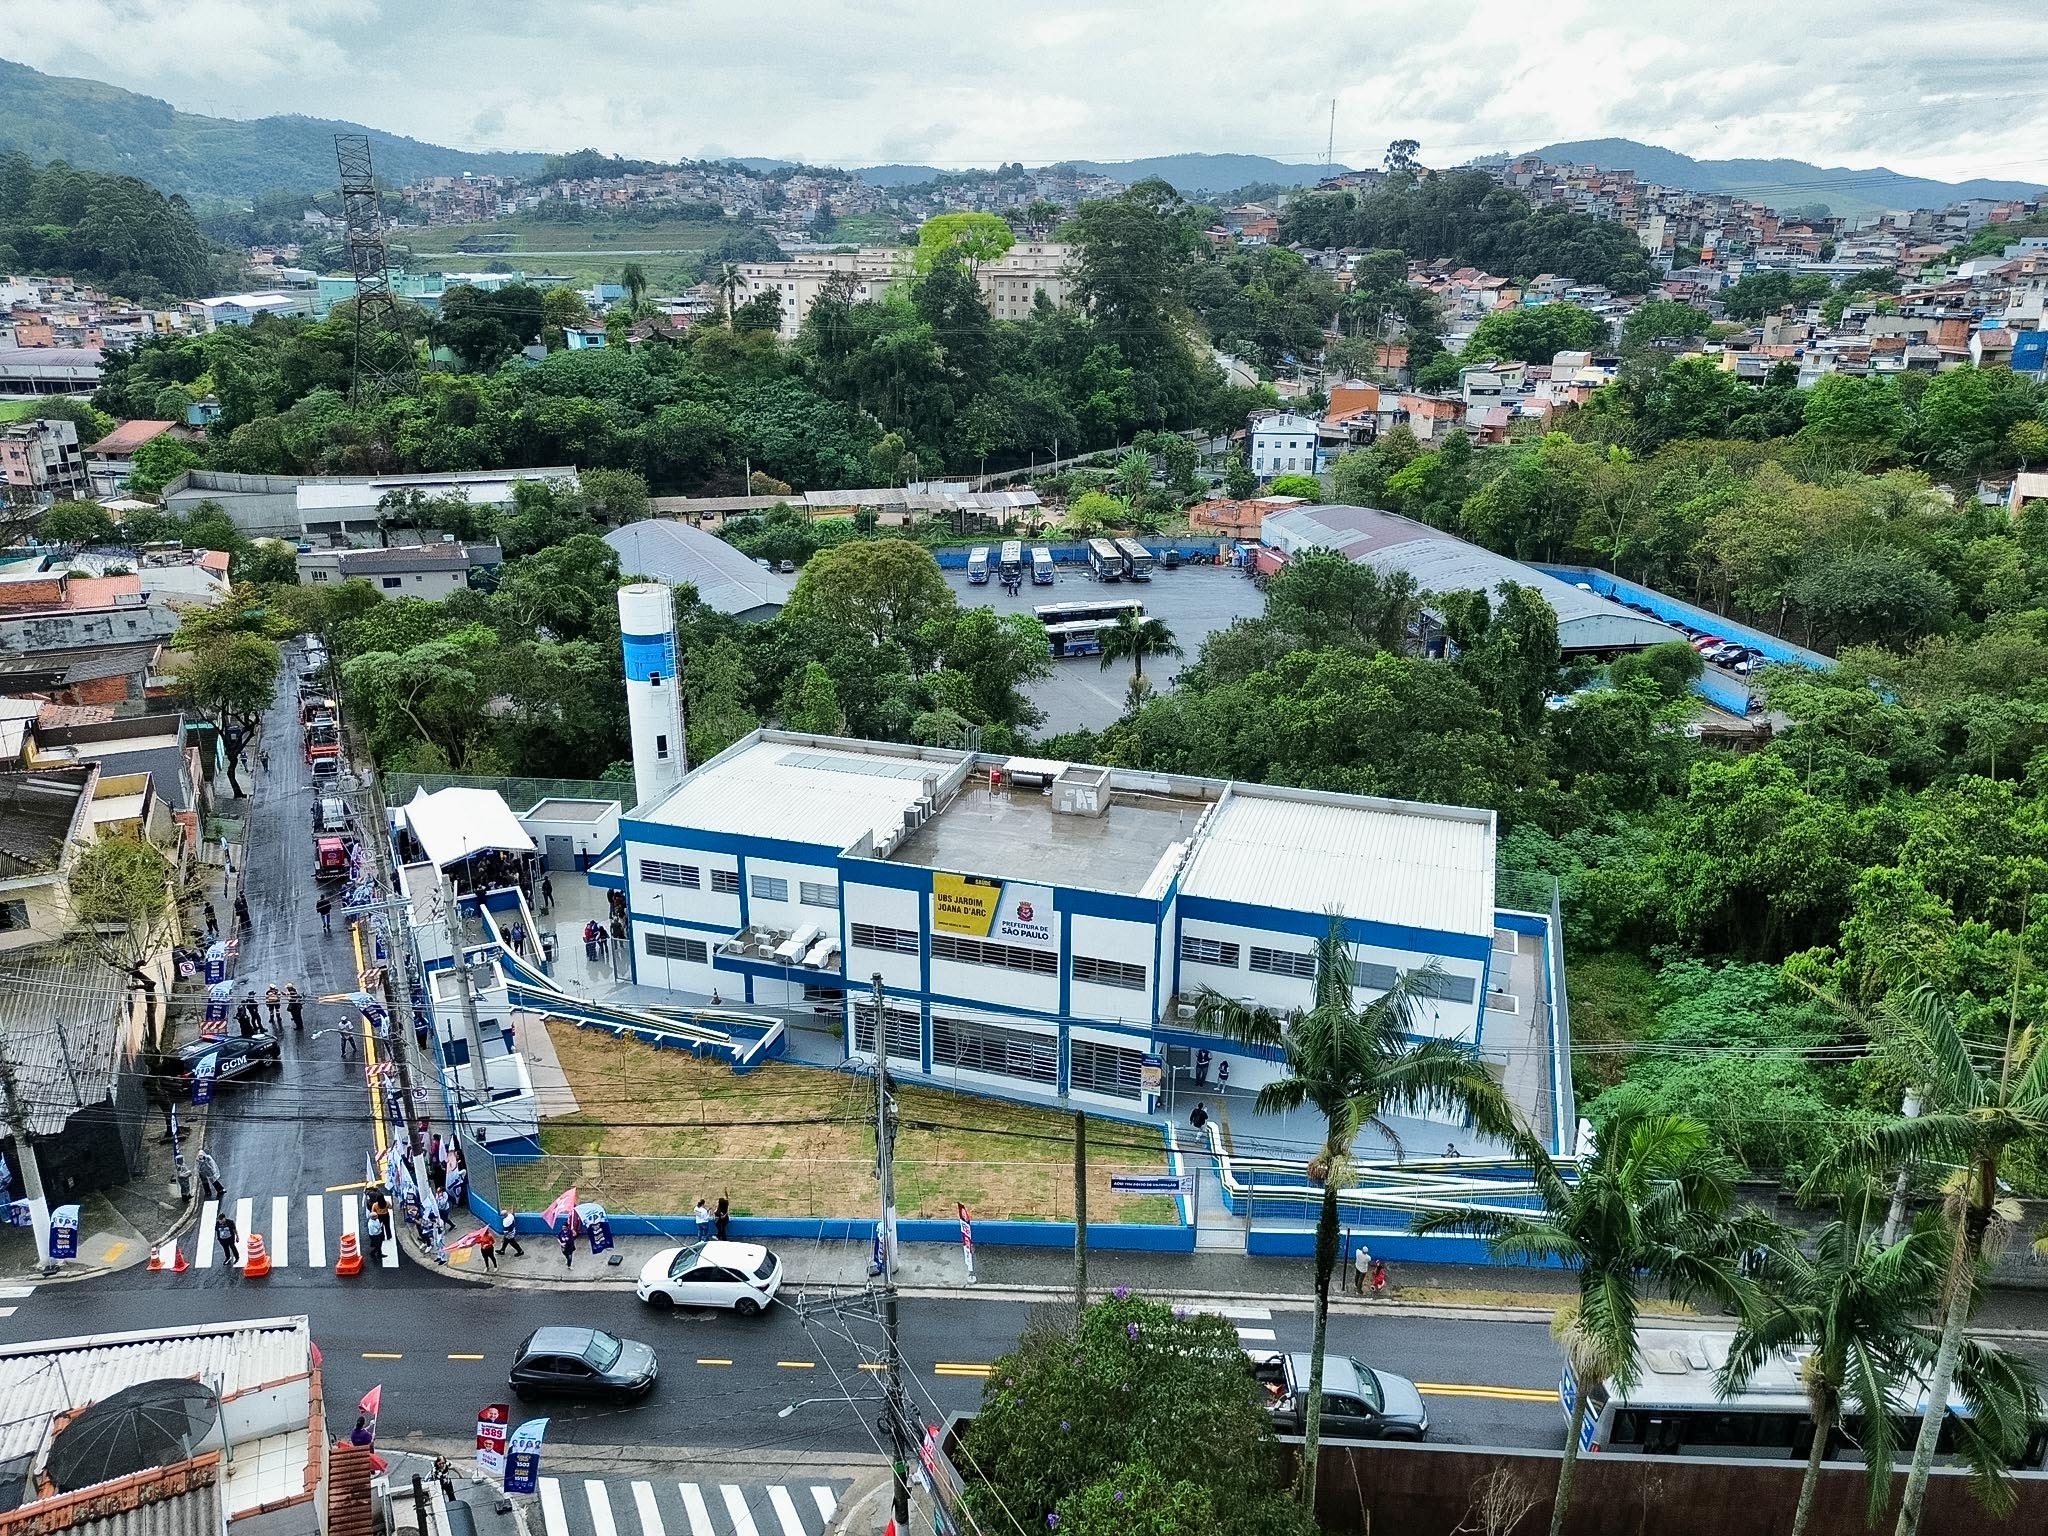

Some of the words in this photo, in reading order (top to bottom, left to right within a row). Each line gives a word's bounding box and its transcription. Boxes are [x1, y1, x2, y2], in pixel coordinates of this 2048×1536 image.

[975, 878, 991, 886] SAÚDE
[937, 894, 952, 902] UBS
[954, 896, 983, 907] JARDIM
[937, 903, 961, 913] JOANA
[963, 906, 986, 917] D'ARC
[1002, 921, 1038, 930] PREFEITURA
[1001, 927, 1018, 936] SÃO
[1020, 930, 1049, 940] PAULO
[221, 1054, 248, 1071] GCM
